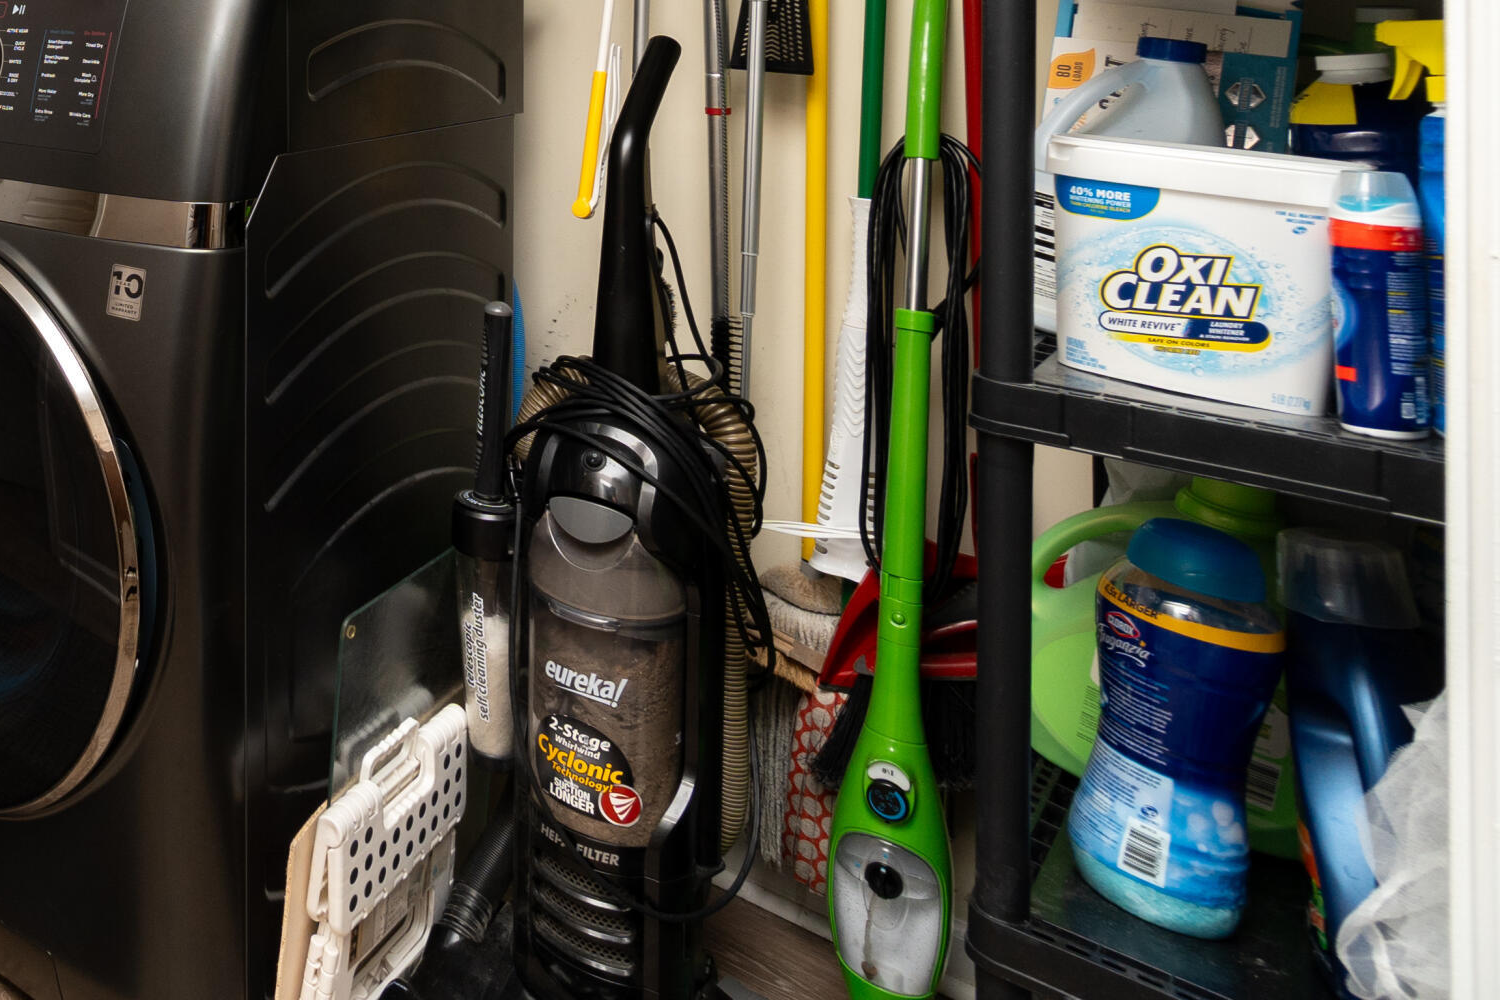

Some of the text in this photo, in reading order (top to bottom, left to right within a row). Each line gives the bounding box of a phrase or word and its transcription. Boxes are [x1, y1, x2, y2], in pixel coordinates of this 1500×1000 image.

[1056, 64, 1072, 78] 80
[1072, 61, 1084, 82] LOADS
[1069, 185, 1132, 202] 40% MORE
[1137, 246, 1229, 286] OXI
[112, 270, 144, 299] 10
[1102, 271, 1257, 318] CLEAN
[1107, 316, 1138, 329] WHITE
[1147, 337, 1164, 345] SAFE
[1180, 341, 1210, 349] COLORS
[472, 591, 484, 638] duster
[1118, 592, 1158, 620] LARGER
[465, 622, 476, 688] telescopic
[475, 638, 488, 695] cleaning
[545, 660, 628, 708] eureka!
[549, 715, 612, 752] 2-Stage
[554, 733, 601, 760] Whirlwind
[538, 733, 624, 785] Cyclonic
[552, 761, 614, 793] Technology!
[553, 777, 591, 801] SUCTION
[549, 782, 595, 815] LONGER
[576, 843, 620, 866] FILTER
